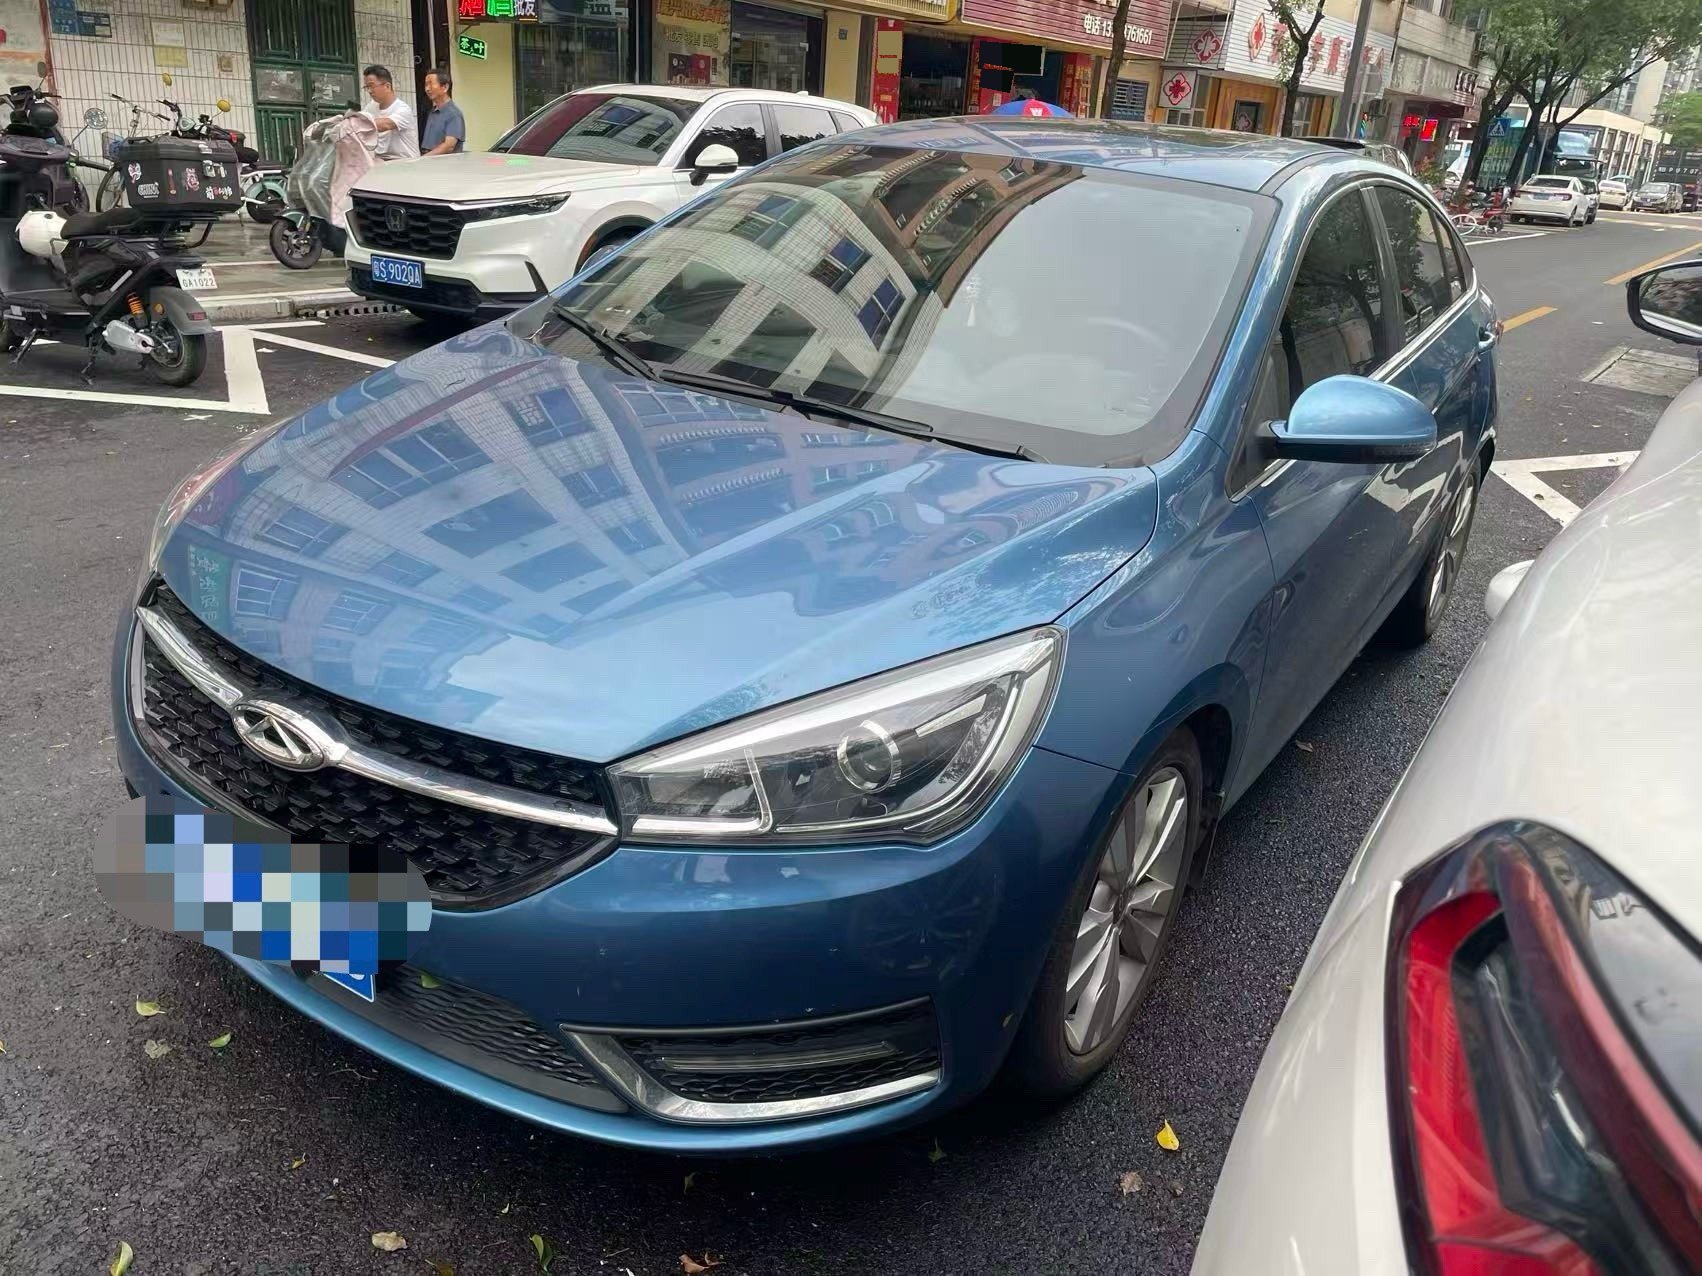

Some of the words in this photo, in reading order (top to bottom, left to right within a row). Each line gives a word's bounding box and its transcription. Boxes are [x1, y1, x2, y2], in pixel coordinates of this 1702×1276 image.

[1083, 12, 1101, 35] 电话
[1102, 20, 1152, 45] 13761661
[460, 37, 485, 54] 茶叶
